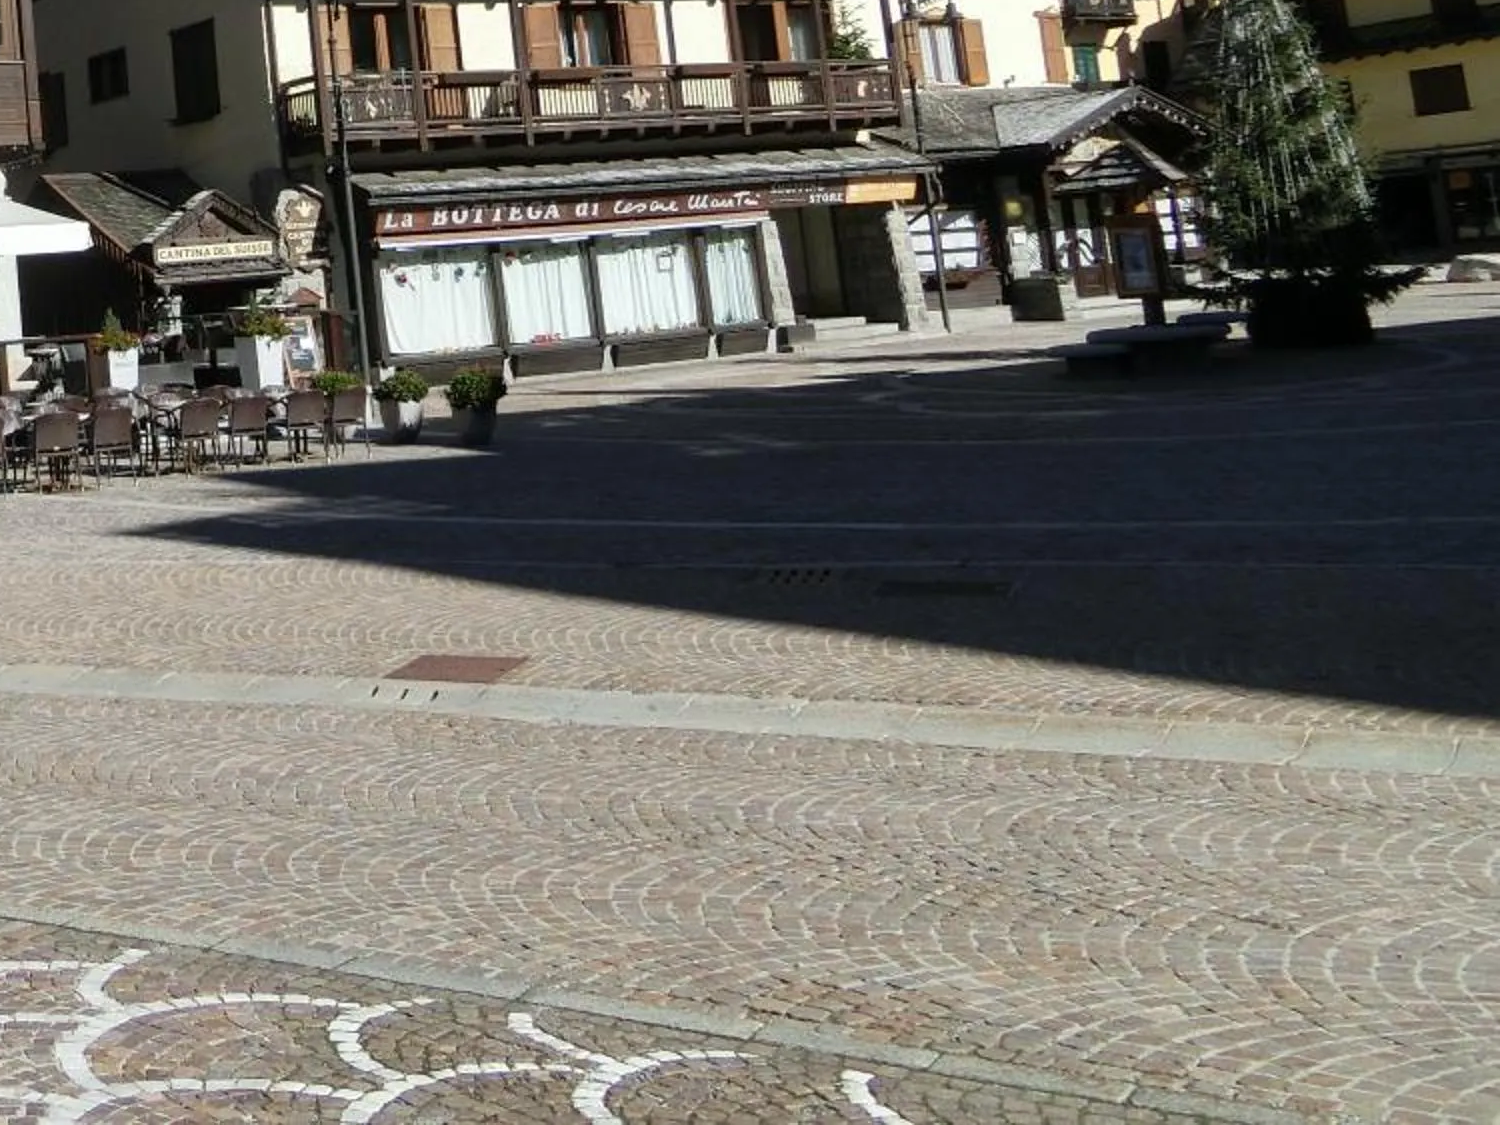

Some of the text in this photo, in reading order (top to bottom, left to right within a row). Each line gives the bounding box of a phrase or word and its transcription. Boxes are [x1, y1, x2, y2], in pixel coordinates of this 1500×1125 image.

[809, 192, 844, 204] STORE
[431, 203, 561, 227] BOTTEGA
[575, 201, 599, 217] di
[158, 242, 270, 261] CANTINA DEL SUISSE
